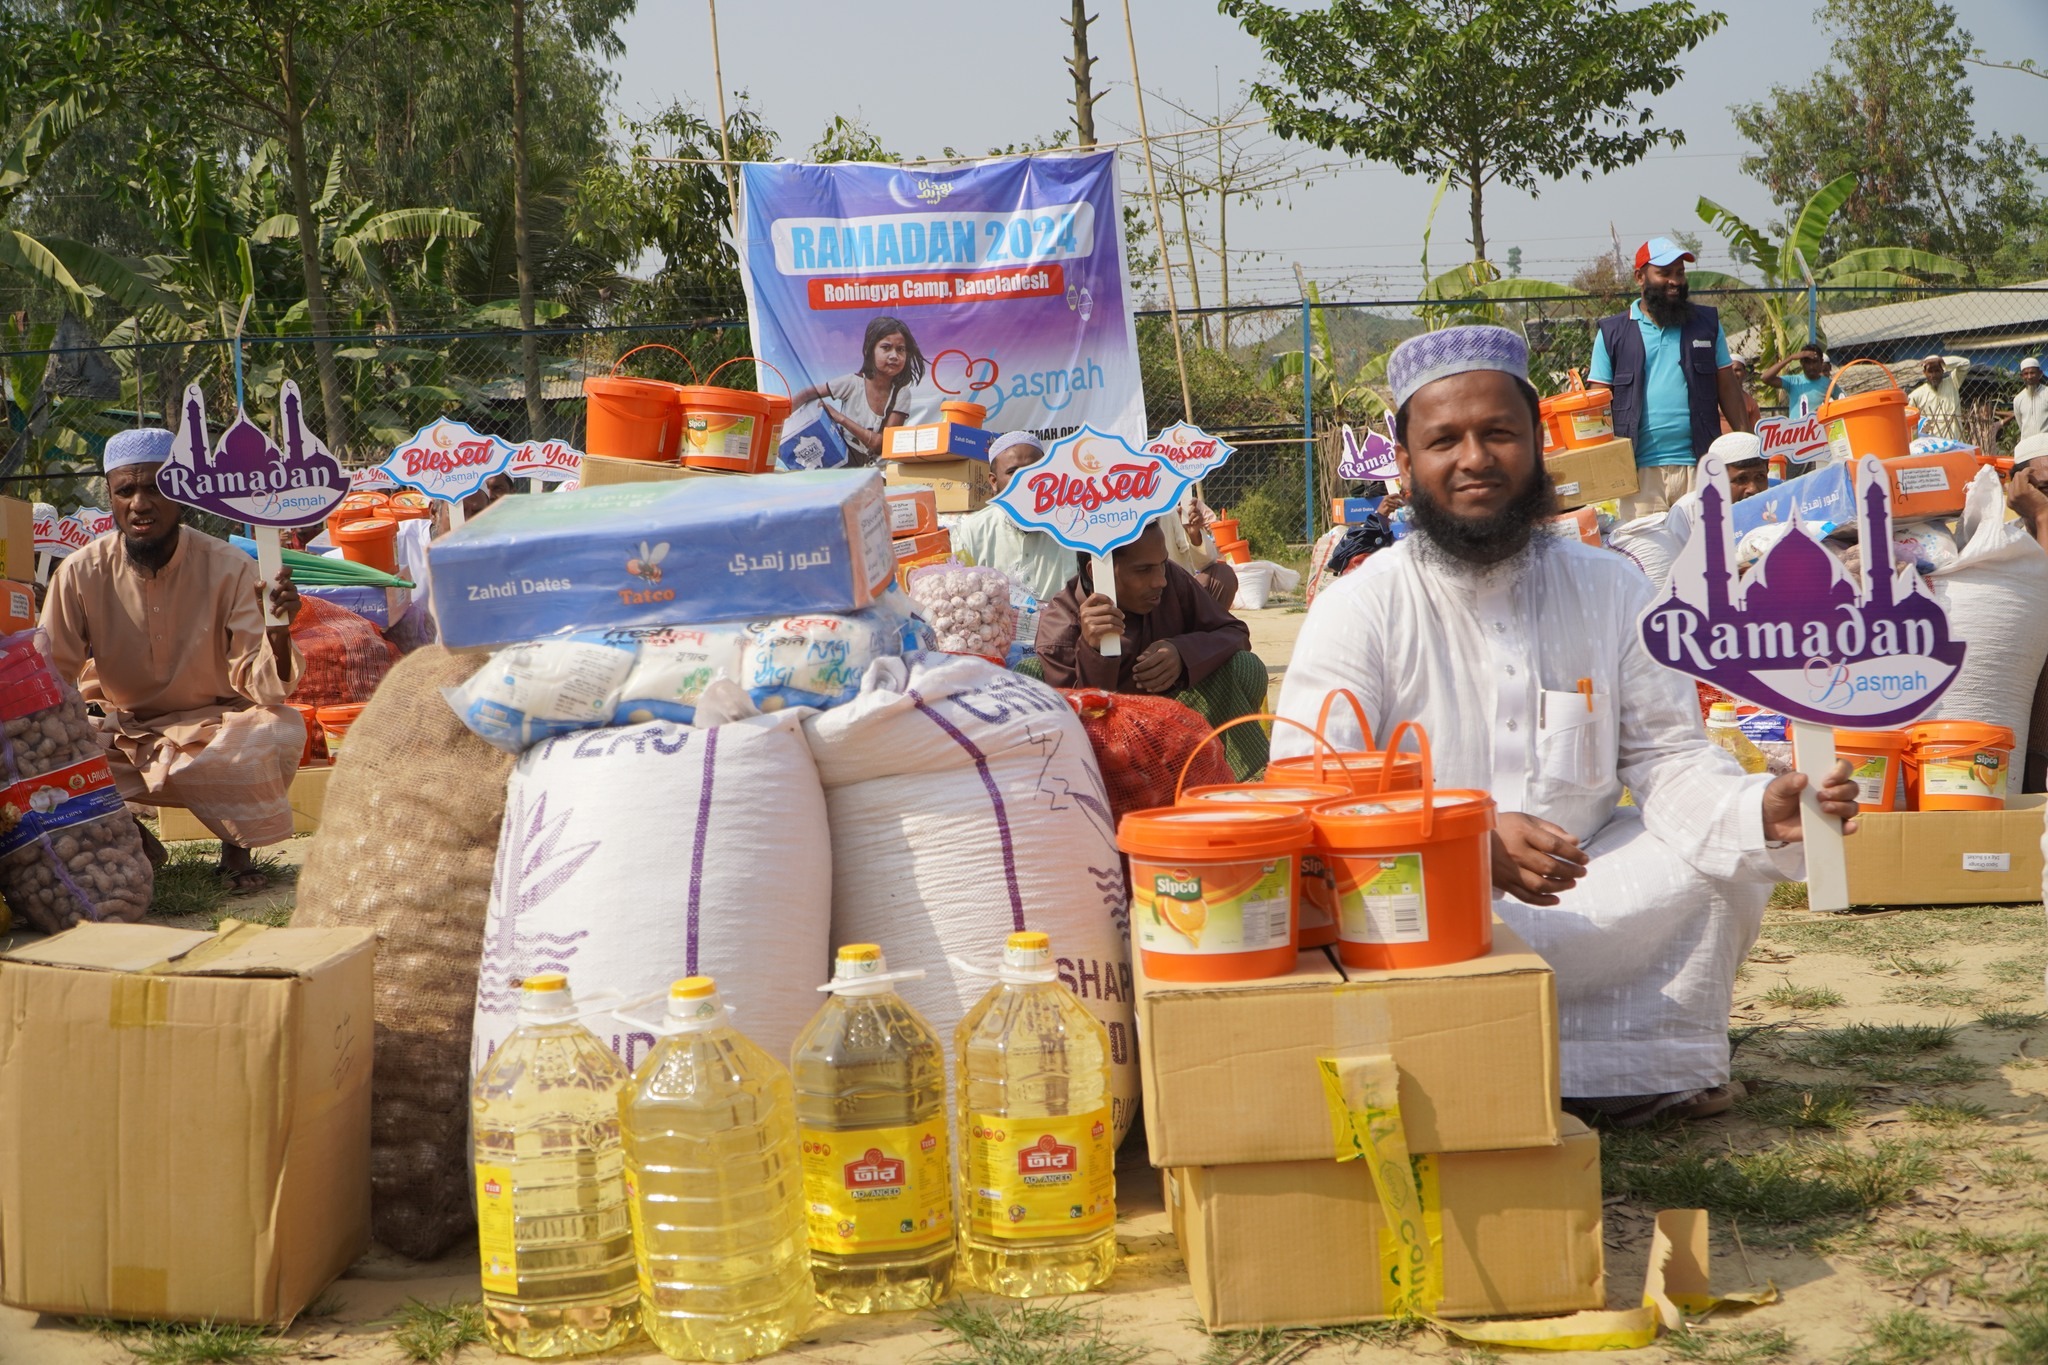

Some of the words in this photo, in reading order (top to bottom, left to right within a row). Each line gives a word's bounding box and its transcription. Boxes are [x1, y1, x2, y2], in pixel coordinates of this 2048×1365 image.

[791, 220, 976, 269] RAMADAN
[984, 212, 1077, 262] 2024
[823, 283, 900, 302] Rohingya
[903, 278, 953, 299] Camp,
[955, 270, 1050, 296] Bangladesh
[1760, 418, 1821, 451] Thank
[402, 439, 494, 477] Blessed
[542, 444, 581, 468] You
[1340, 446, 1396, 477] Ramad
[162, 460, 330, 500] Ramadan
[421, 469, 479, 491] Basmah
[1027, 461, 1162, 516] Blessed
[251, 490, 327, 517] Basmah
[1054, 504, 1139, 537] Basmah
[728, 550, 784, 576] زهدي
[789, 547, 831, 570] تمور
[467, 582, 517, 601] Zahdi
[521, 578, 572, 594] Dates
[618, 588, 676, 606] Tatco
[1650, 604, 1935, 672] Ramadan
[1803, 657, 1928, 710] Basmah
[1975, 754, 1998, 766] Sipco
[1301, 858, 1325, 873] Sip
[1156, 877, 1199, 897] Sipco
[1026, 1151, 1069, 1169] তীর
[853, 1165, 897, 1182] তীর
